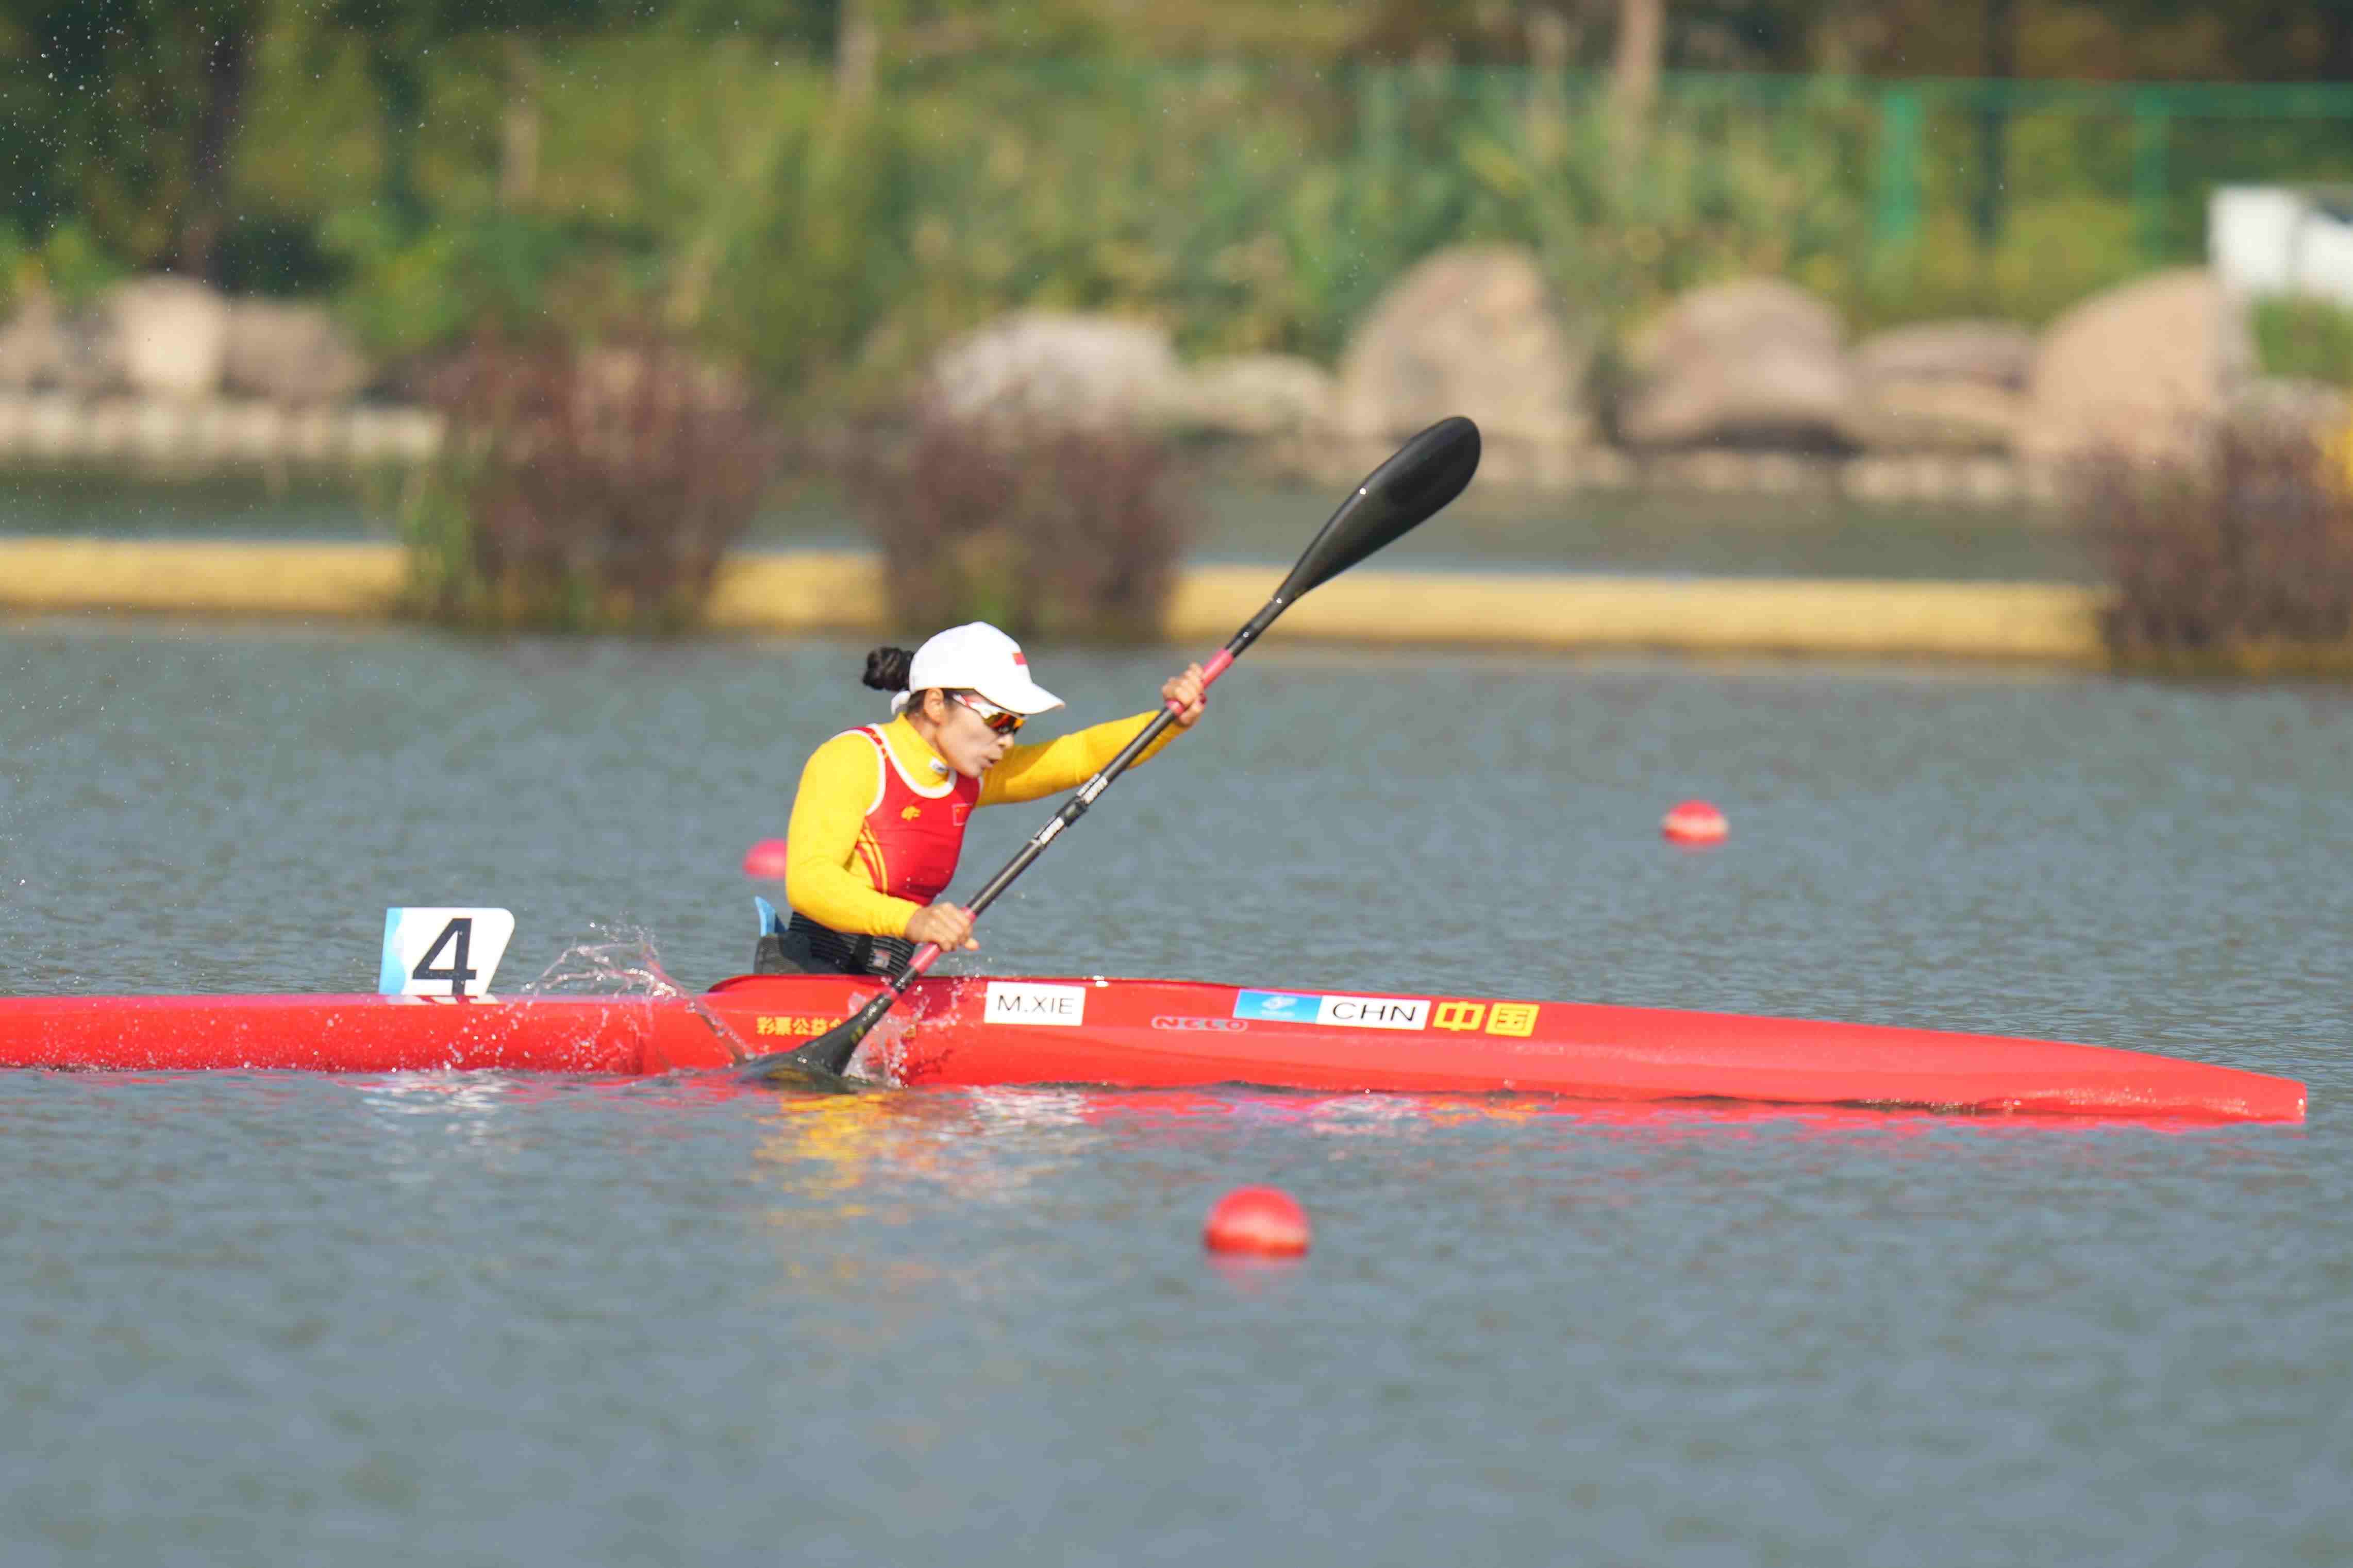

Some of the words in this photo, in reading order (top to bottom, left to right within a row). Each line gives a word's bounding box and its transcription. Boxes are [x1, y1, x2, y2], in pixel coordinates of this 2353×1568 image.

[412, 918, 477, 995] 4
[998, 994, 1075, 1015] M.XIE
[1332, 1002, 1416, 1022] CHN
[1432, 1001, 1540, 1037] 中国
